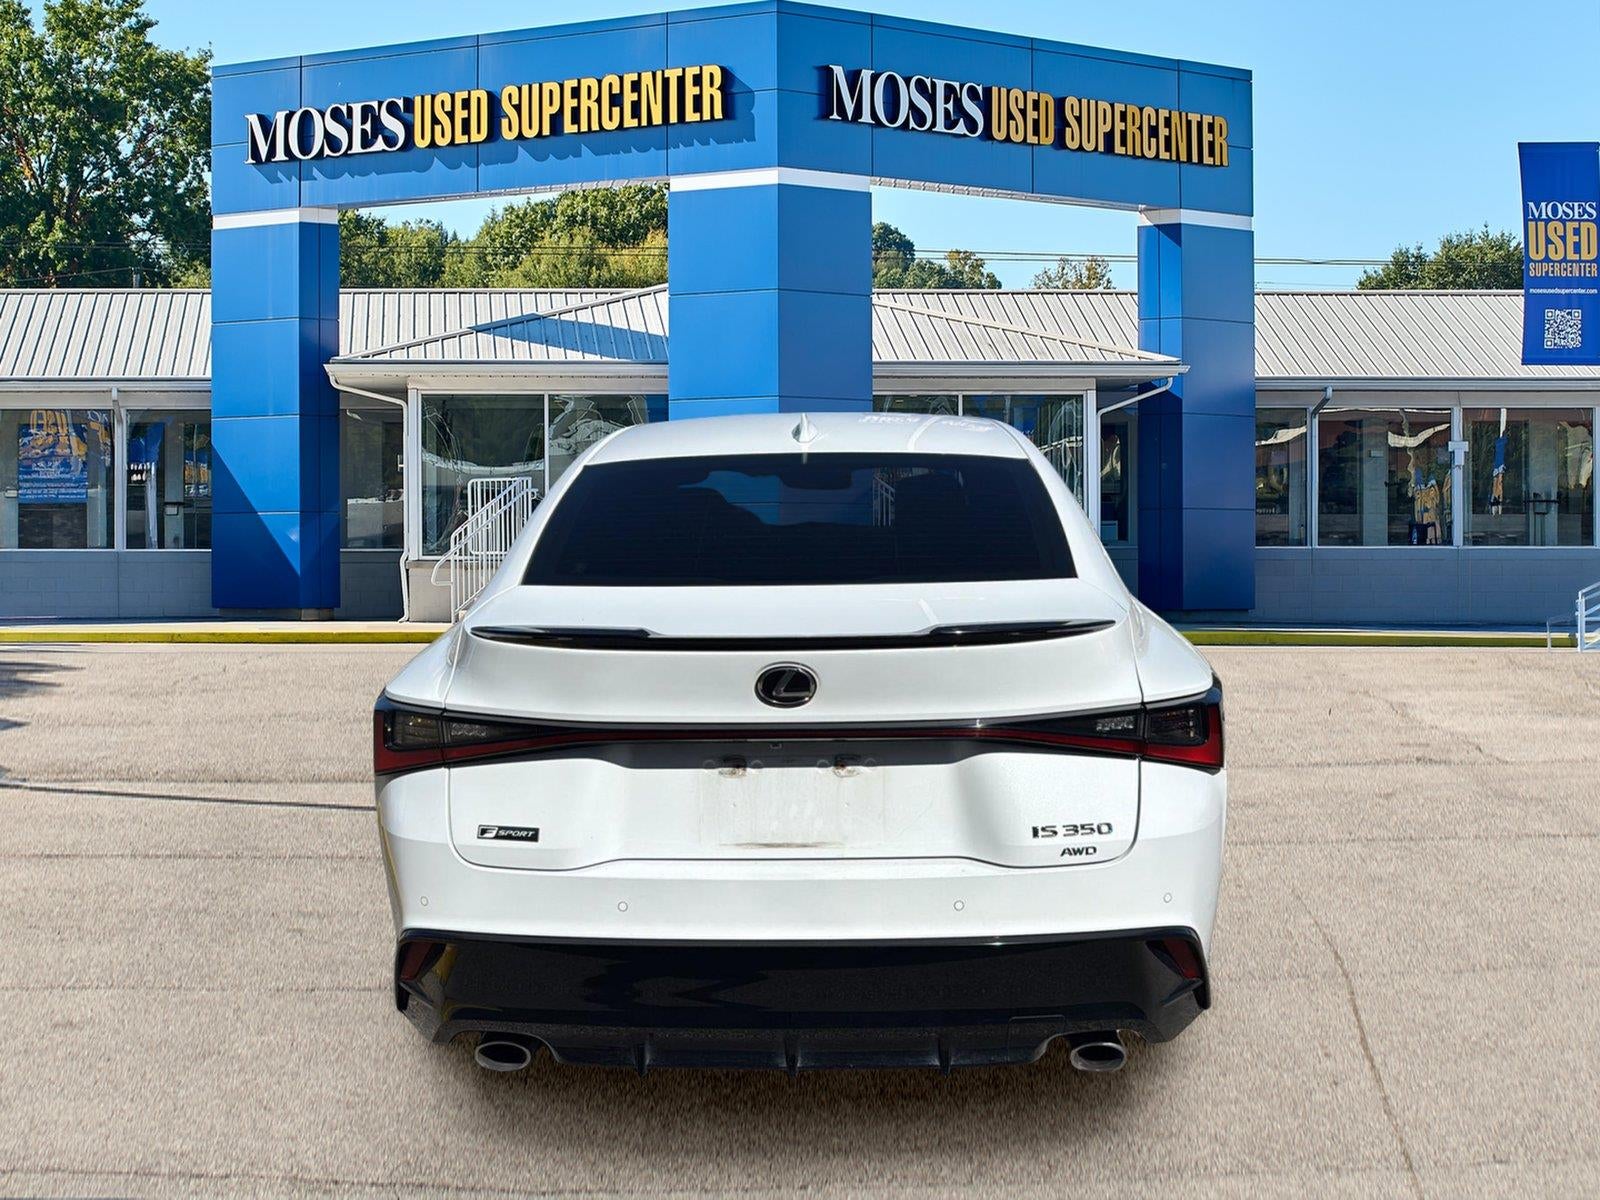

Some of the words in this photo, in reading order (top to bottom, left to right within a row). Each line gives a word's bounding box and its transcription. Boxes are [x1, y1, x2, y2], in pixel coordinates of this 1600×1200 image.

[244, 97, 404, 163] MOSES
[414, 88, 488, 148] USED
[501, 64, 723, 140] SUPERCENTER
[828, 64, 983, 137] MOSES
[991, 86, 1055, 145] USED
[1064, 95, 1230, 167] SUPERCENTER
[1528, 201, 1597, 219] MOSES
[1528, 221, 1598, 261] USED
[1529, 263, 1598, 277] SUPERCENTER
[498, 829, 535, 837] SPORT
[1032, 825, 1058, 839] IS
[1062, 822, 1113, 837] 350
[1060, 846, 1097, 857] AWD
